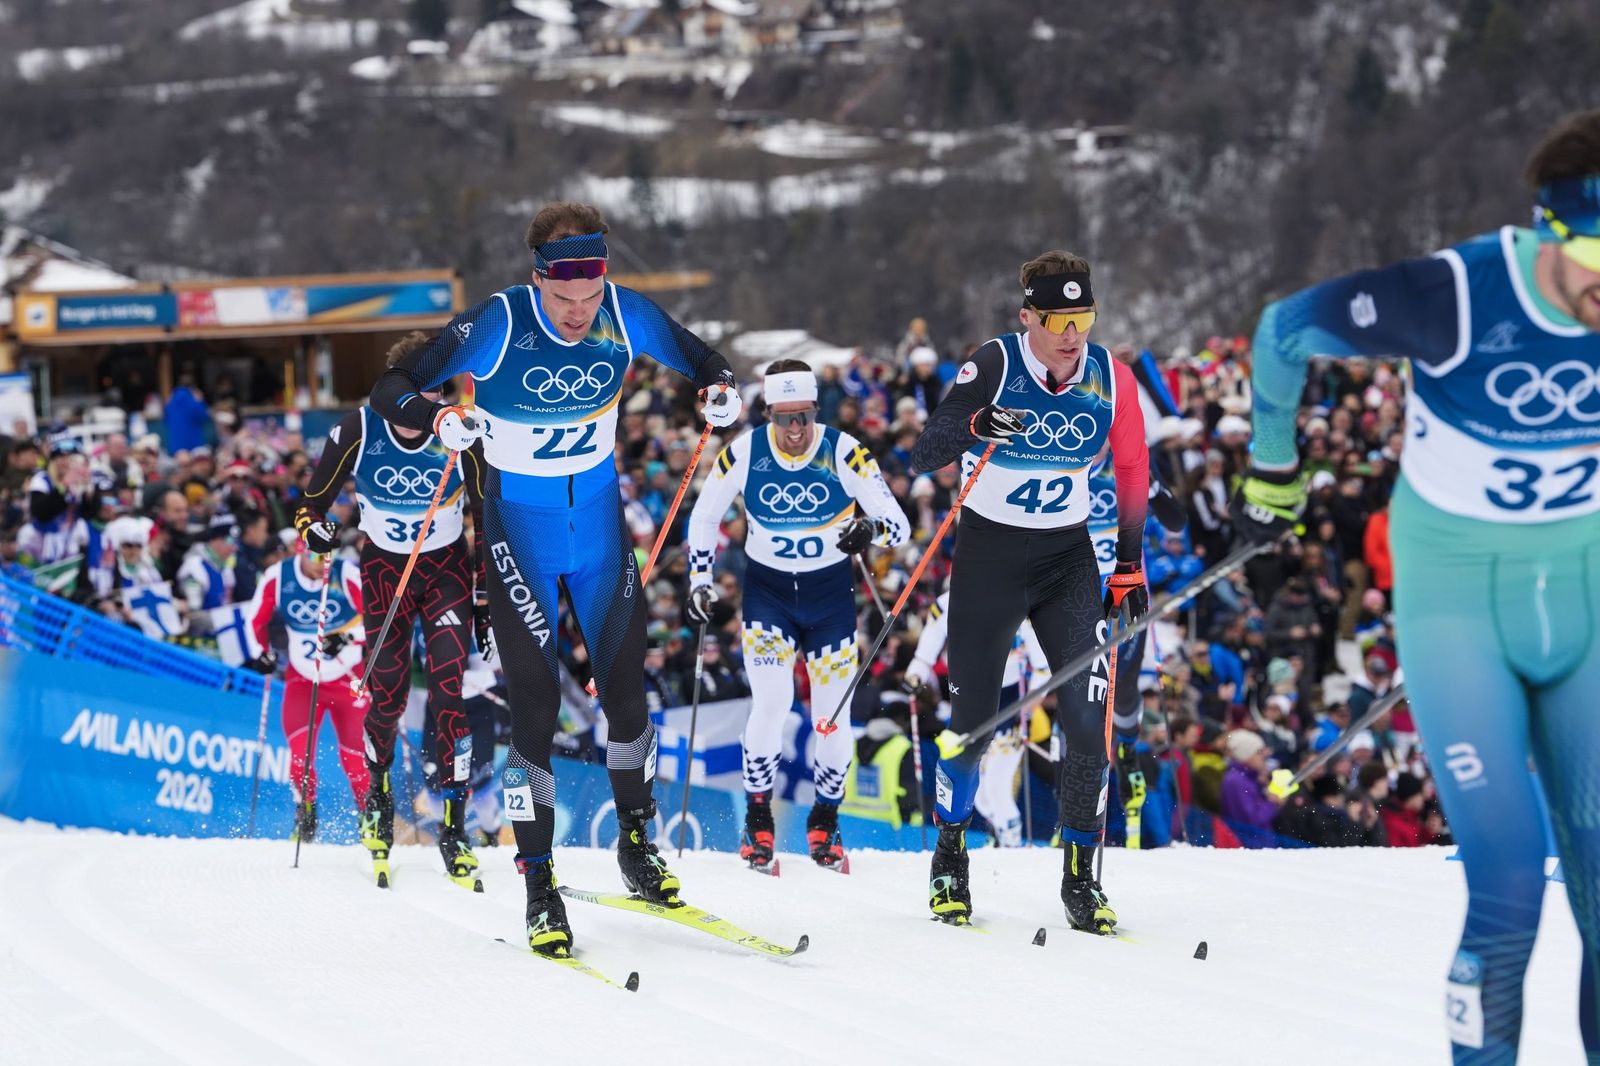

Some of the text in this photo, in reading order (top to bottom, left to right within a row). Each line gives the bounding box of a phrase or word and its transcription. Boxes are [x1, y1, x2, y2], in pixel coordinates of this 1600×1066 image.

[513, 403, 556, 413] MILANO
[558, 403, 599, 412] CORTINA
[532, 421, 597, 460] 22
[1000, 449, 1040, 461] MILANO
[1041, 454, 1082, 463] CORTINA
[1005, 475, 1074, 514] 42
[1485, 457, 1599, 511] 32
[372, 495, 401, 505] MILANO
[385, 517, 436, 543] 38
[757, 514, 786, 523] MILANO
[771, 535, 824, 559] 20
[623, 552, 635, 598] odlo
[490, 541, 551, 649] ESTONIA
[753, 656, 785, 667] SWE
[60, 708, 186, 765] MILANO
[156, 767, 214, 815] 2026
[508, 793, 526, 811] 22
[645, 903, 666, 914] FISCHER
